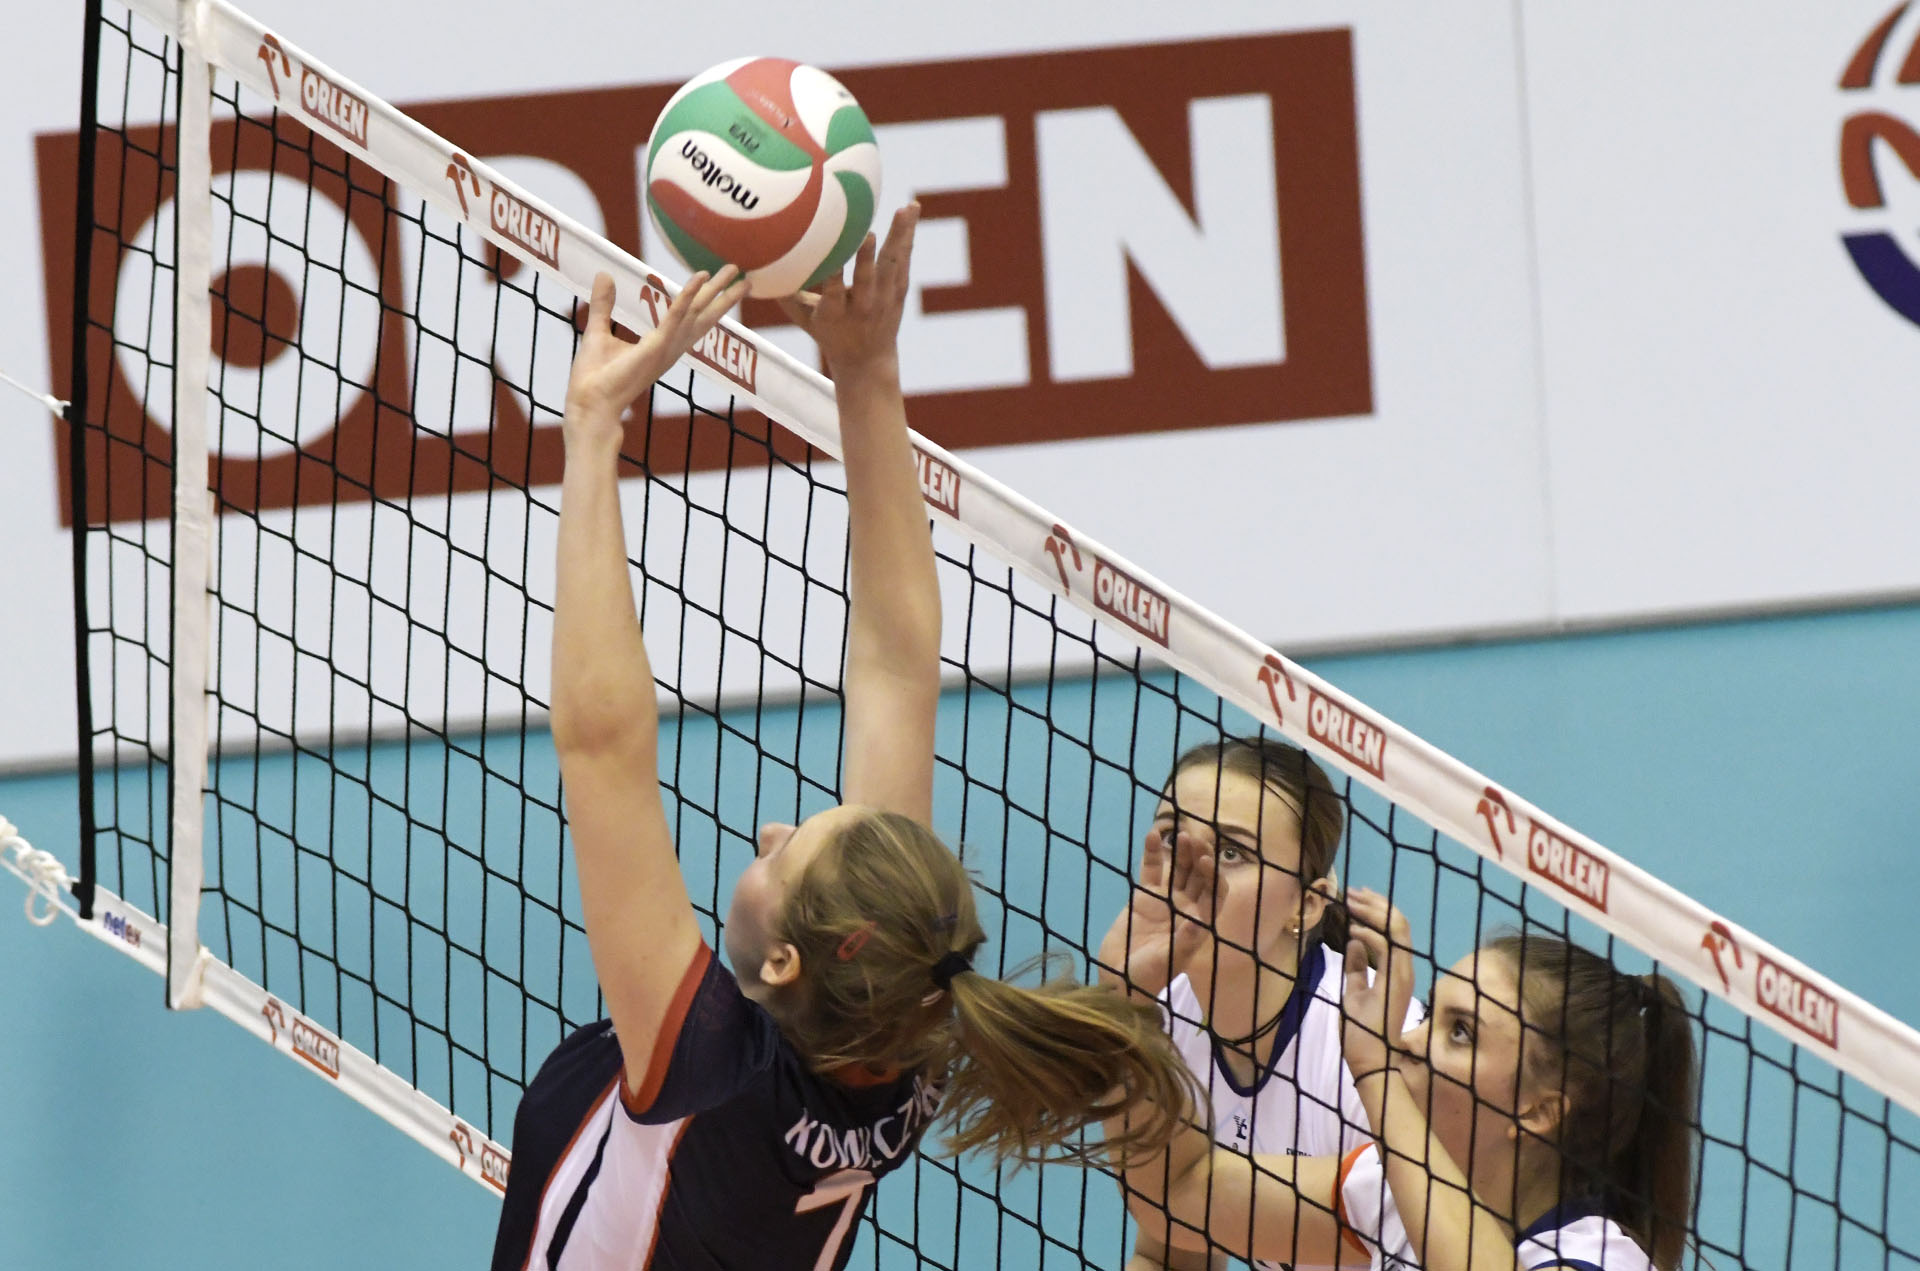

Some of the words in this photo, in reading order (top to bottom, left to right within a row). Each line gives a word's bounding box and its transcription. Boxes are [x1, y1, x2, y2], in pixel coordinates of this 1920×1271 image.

[303, 72, 366, 140] ORLEN
[682, 139, 760, 211] molten
[493, 191, 556, 261] ORLEN
[911, 449, 957, 511] LEN
[1097, 566, 1166, 639] ORLEN
[1311, 696, 1383, 771] ORLEN
[1531, 829, 1606, 904] ORLEN
[1760, 964, 1834, 1039] ORLEN
[795, 1168, 876, 1271] 7
